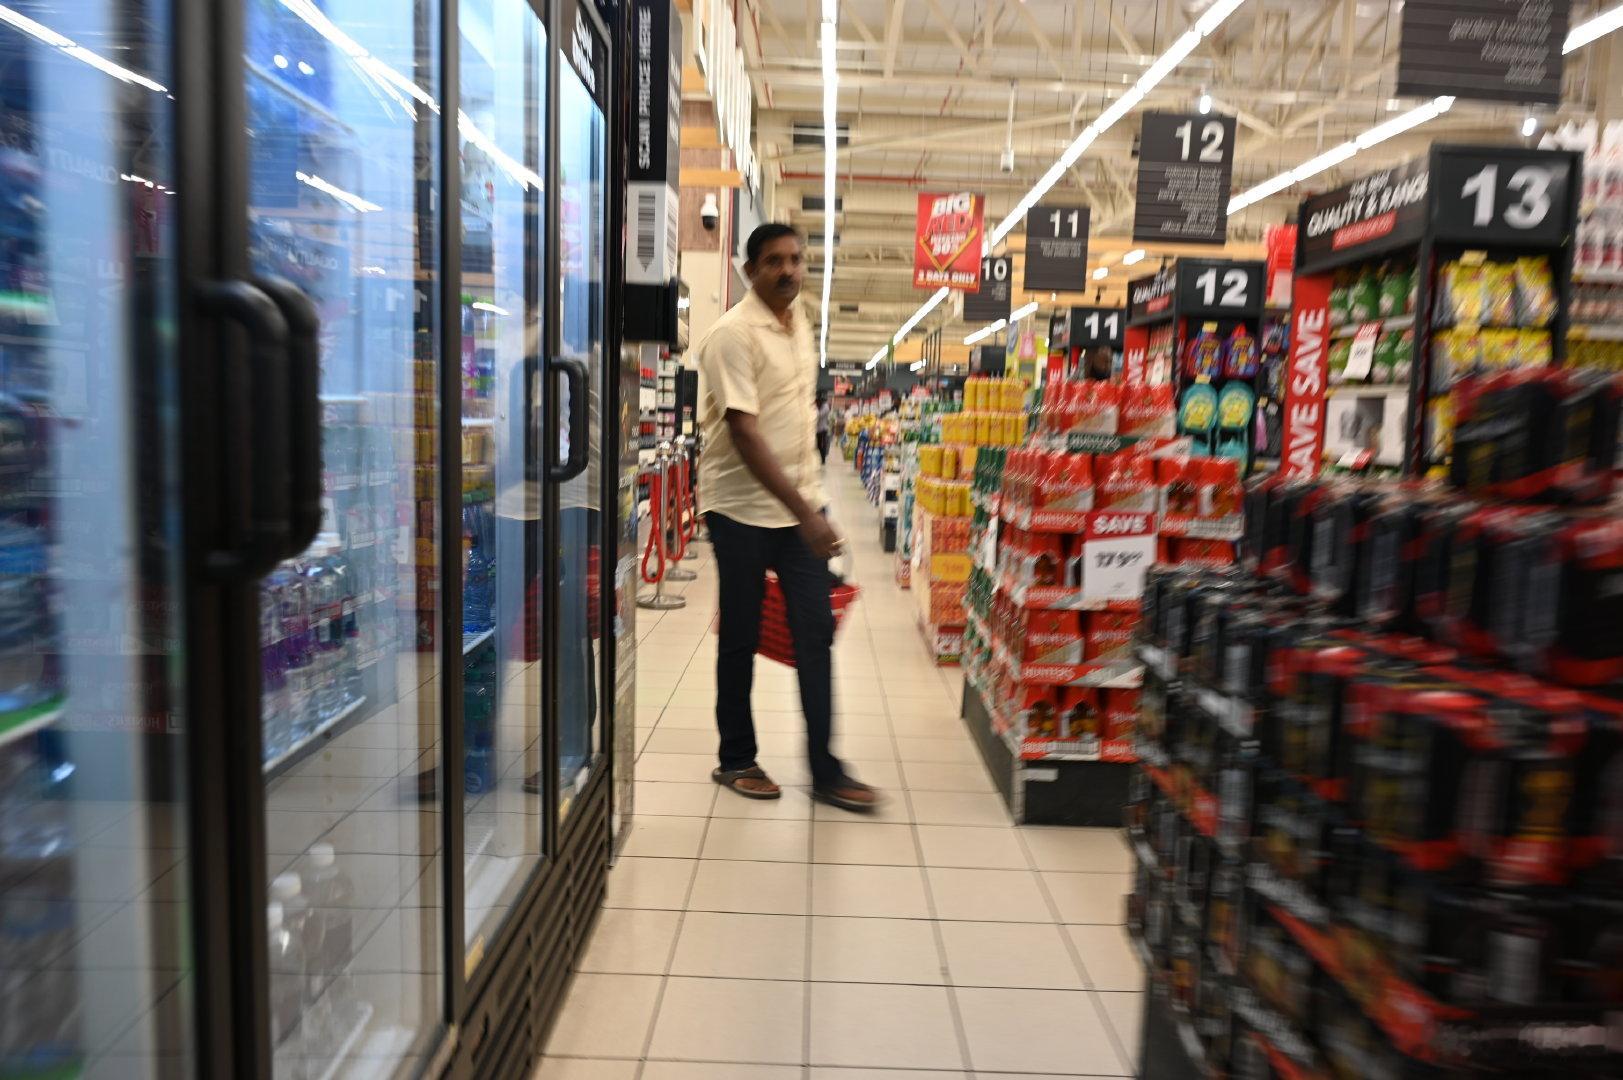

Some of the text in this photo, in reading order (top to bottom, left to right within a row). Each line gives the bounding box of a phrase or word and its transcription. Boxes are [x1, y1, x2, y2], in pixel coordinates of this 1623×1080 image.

[639, 6, 652, 169] SCAN PRICE HERE
[1175, 120, 1225, 163] 12
[1307, 197, 1366, 237] QUALITY
[1461, 164, 1552, 230] 13
[1049, 209, 1079, 239] 11
[982, 258, 1008, 281] 10
[1195, 267, 1249, 307] 12
[1084, 312, 1119, 340] 11
[1292, 307, 1326, 397] SAVE
[1093, 514, 1147, 534] SAVE
